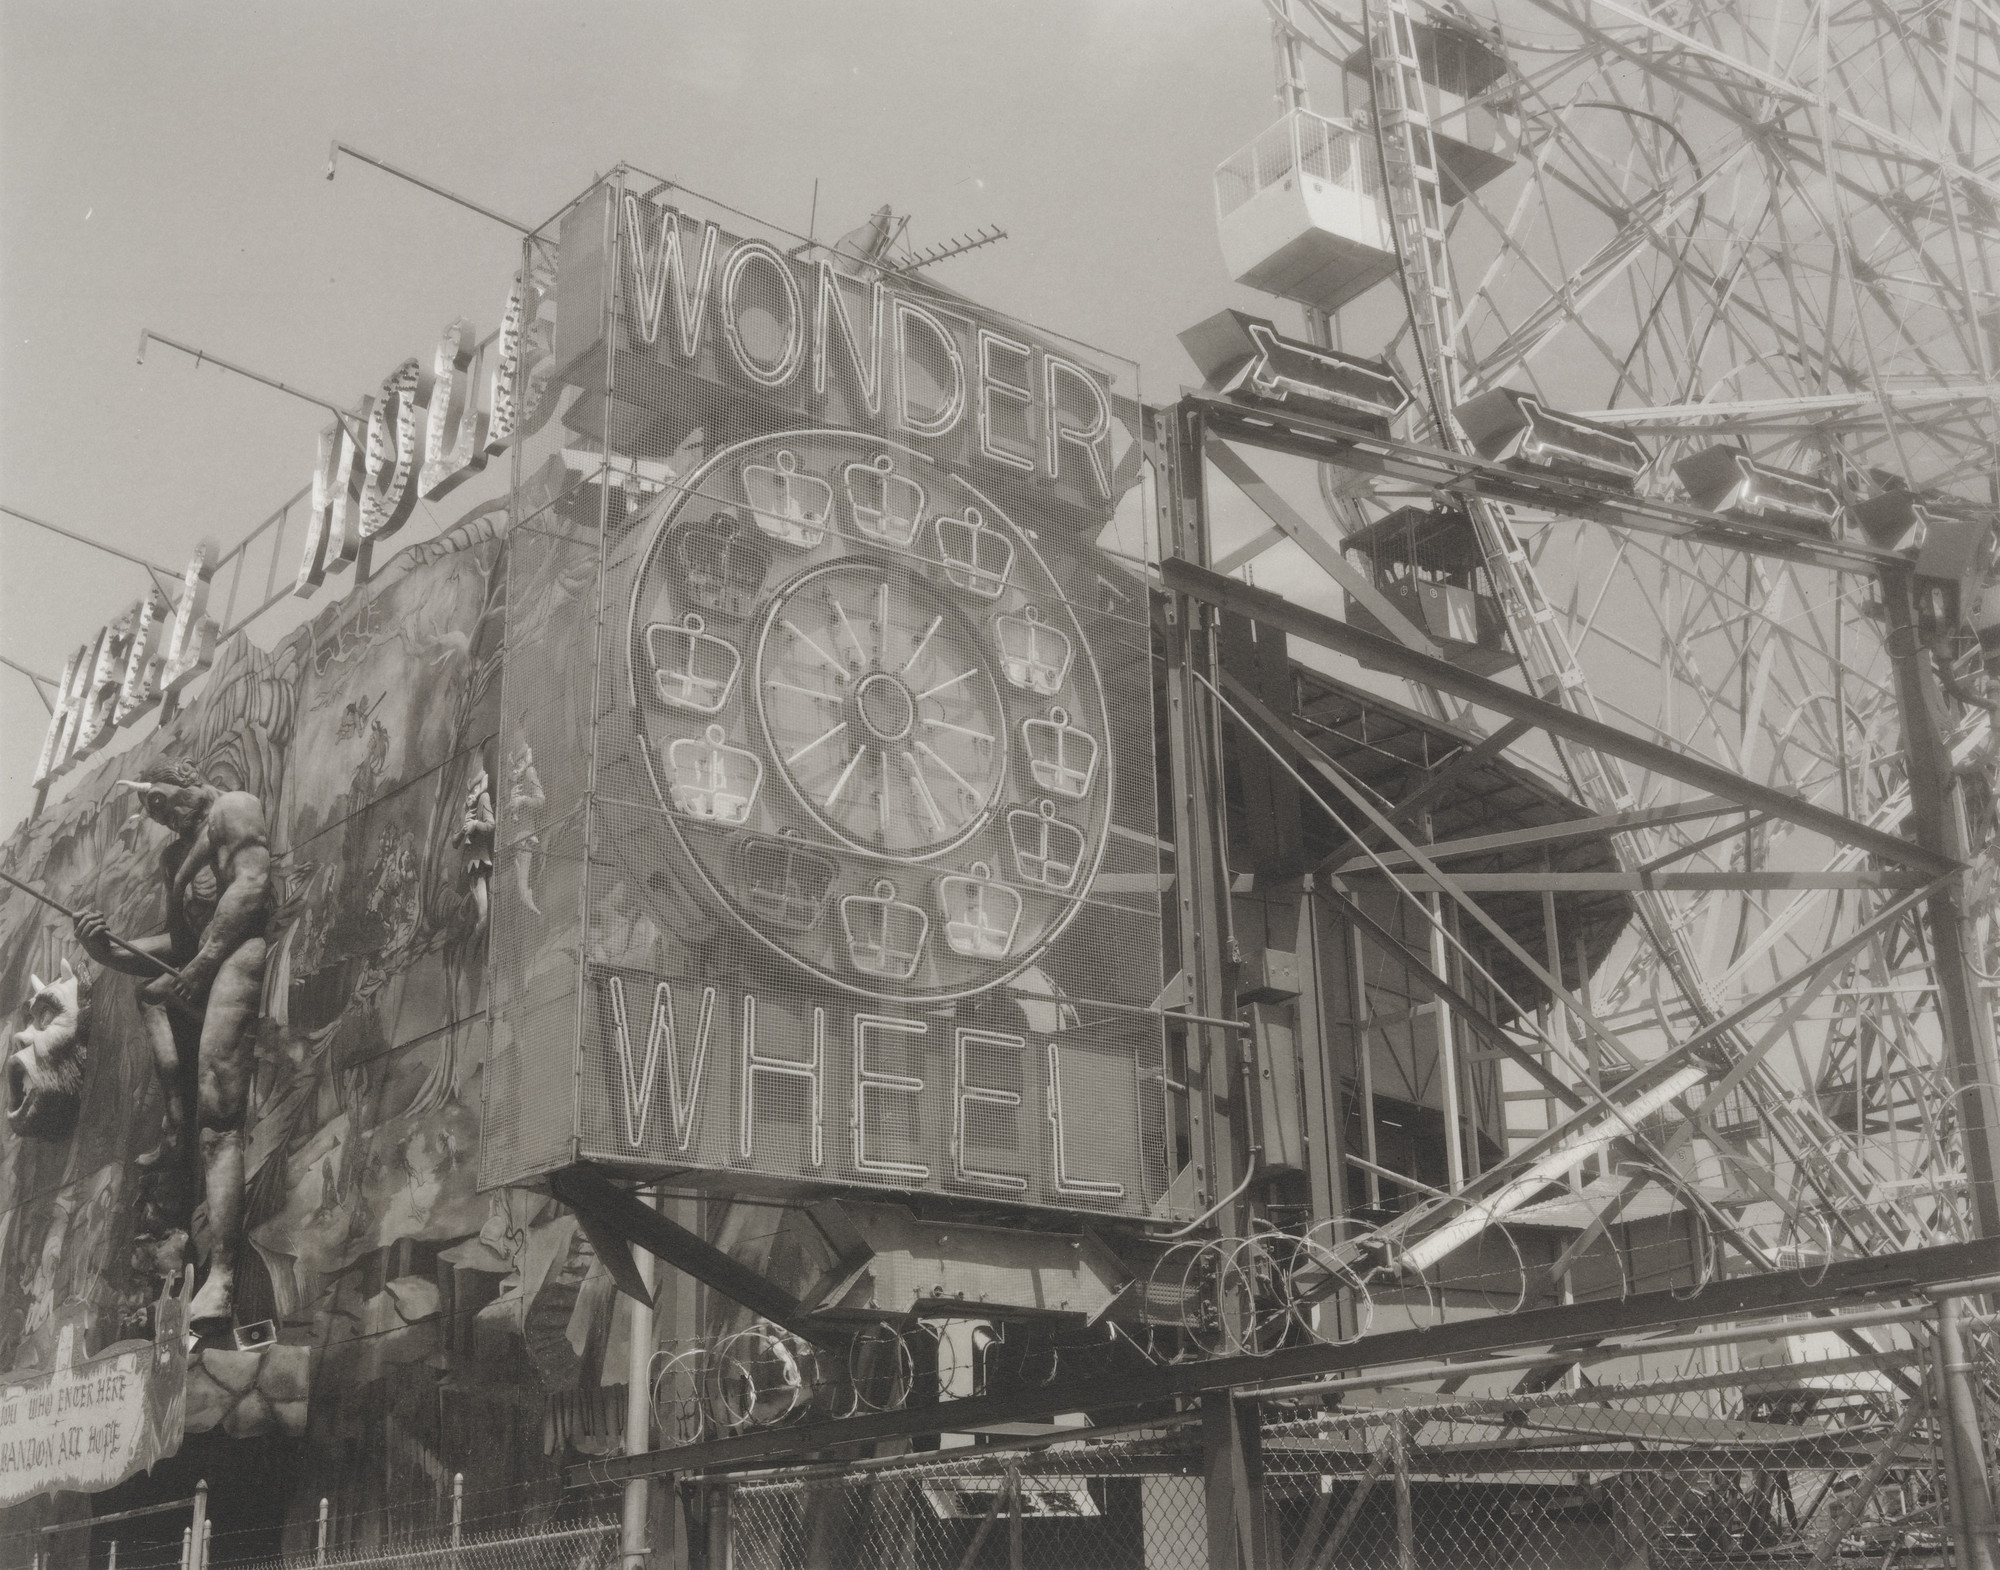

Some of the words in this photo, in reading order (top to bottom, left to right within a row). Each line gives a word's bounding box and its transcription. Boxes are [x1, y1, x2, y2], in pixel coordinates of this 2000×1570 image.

[624, 194, 1113, 500] WONDER
[609, 975, 1125, 1198] WHEEL
[0, 1434, 55, 1473] BANDON
[87, 1420, 120, 1462] HOPE
[28, 1392, 53, 1420] WHO
[57, 1382, 94, 1413] ENTER
[96, 1375, 126, 1404] HERE
